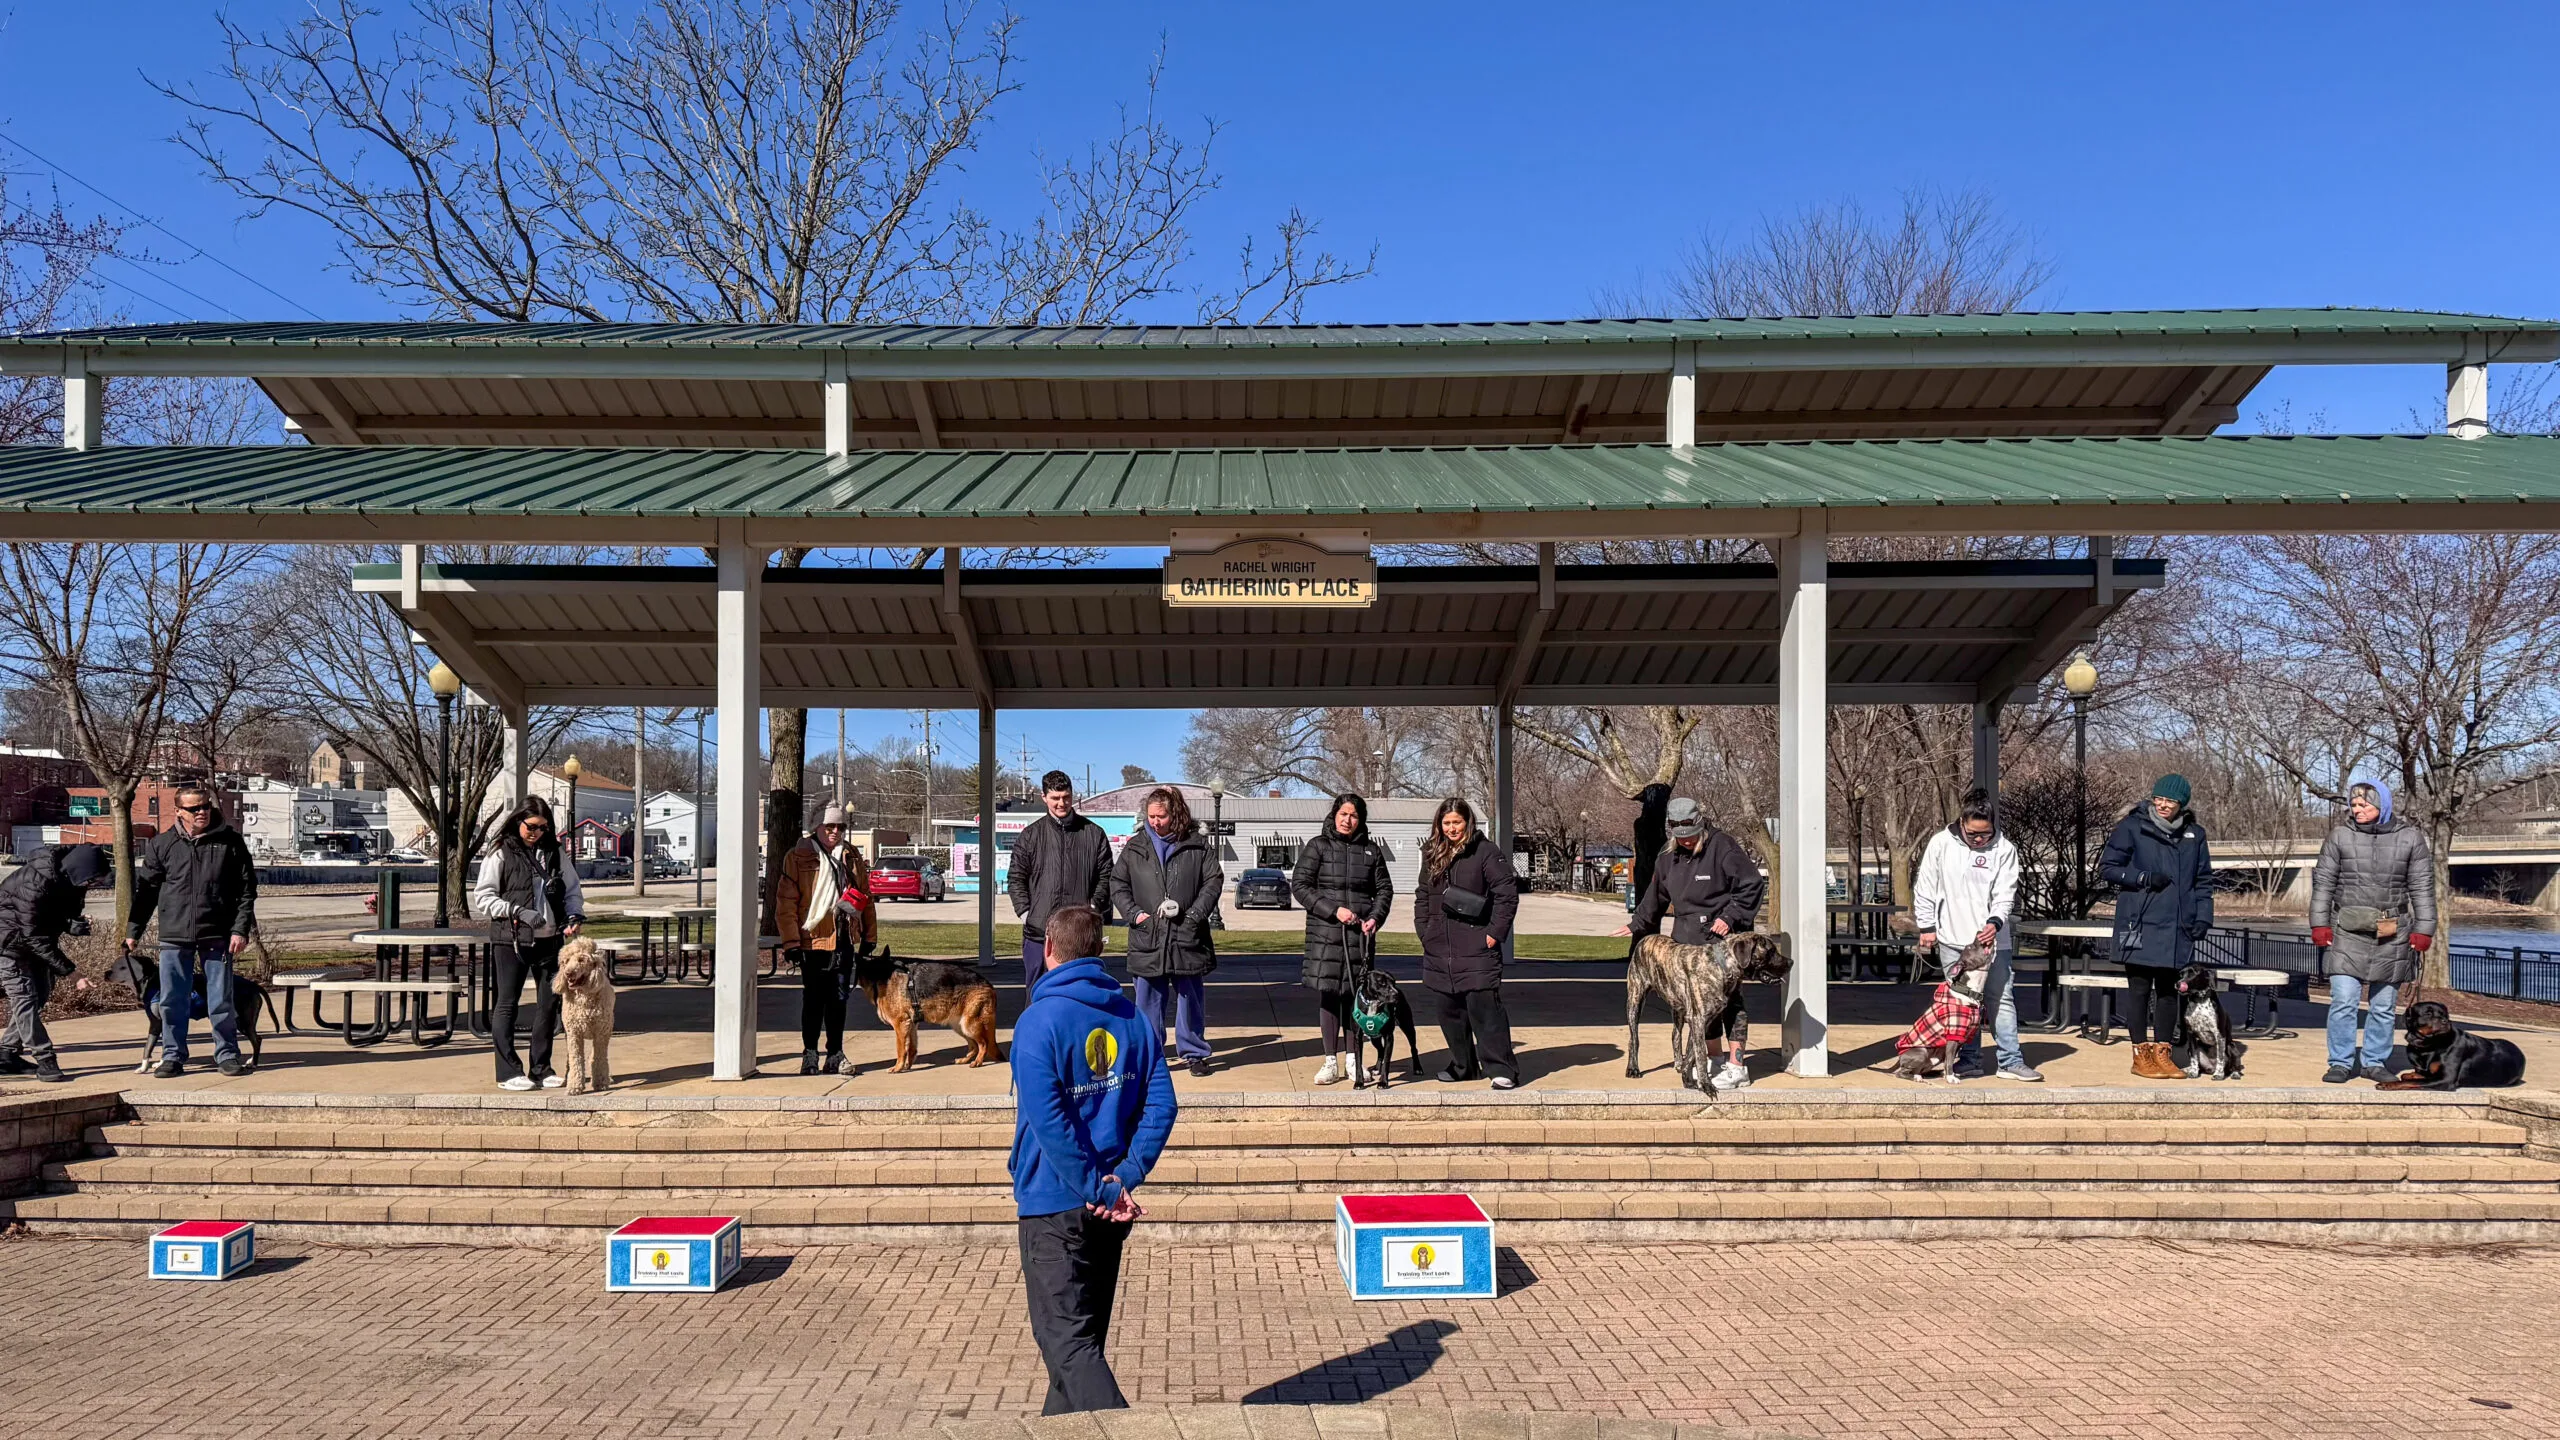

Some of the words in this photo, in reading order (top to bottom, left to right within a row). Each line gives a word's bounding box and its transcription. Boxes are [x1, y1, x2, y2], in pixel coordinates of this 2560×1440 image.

[1223, 561, 1267, 573] RACHEL
[1271, 561, 1316, 573] WRIGHT
[1181, 577, 1291, 597] GATHERING
[1298, 578, 1359, 597] PLACE
[1065, 1082, 1098, 1094] raining
